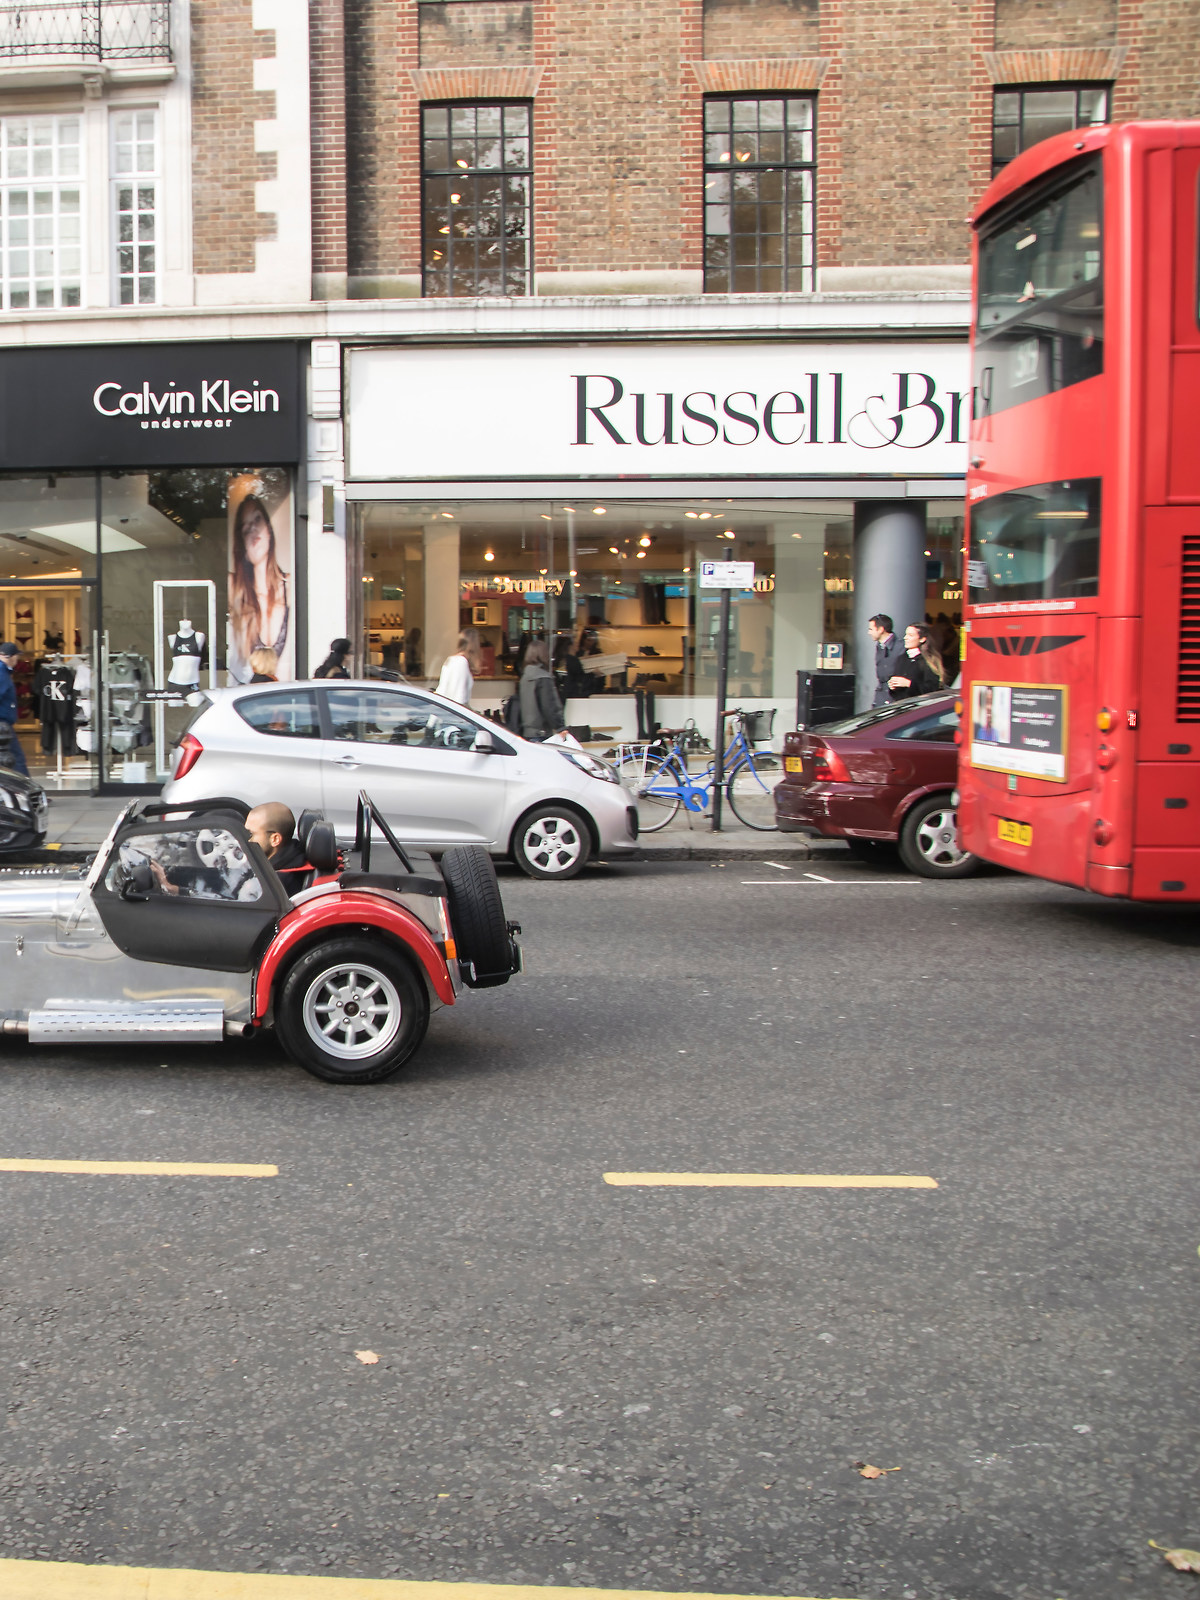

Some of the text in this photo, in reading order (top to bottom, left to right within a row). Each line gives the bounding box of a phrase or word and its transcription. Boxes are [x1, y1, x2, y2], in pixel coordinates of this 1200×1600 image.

[93, 379, 280, 416] Calvin Klein
[569, 372, 847, 446] Russell
[140, 417, 232, 429] underwear
